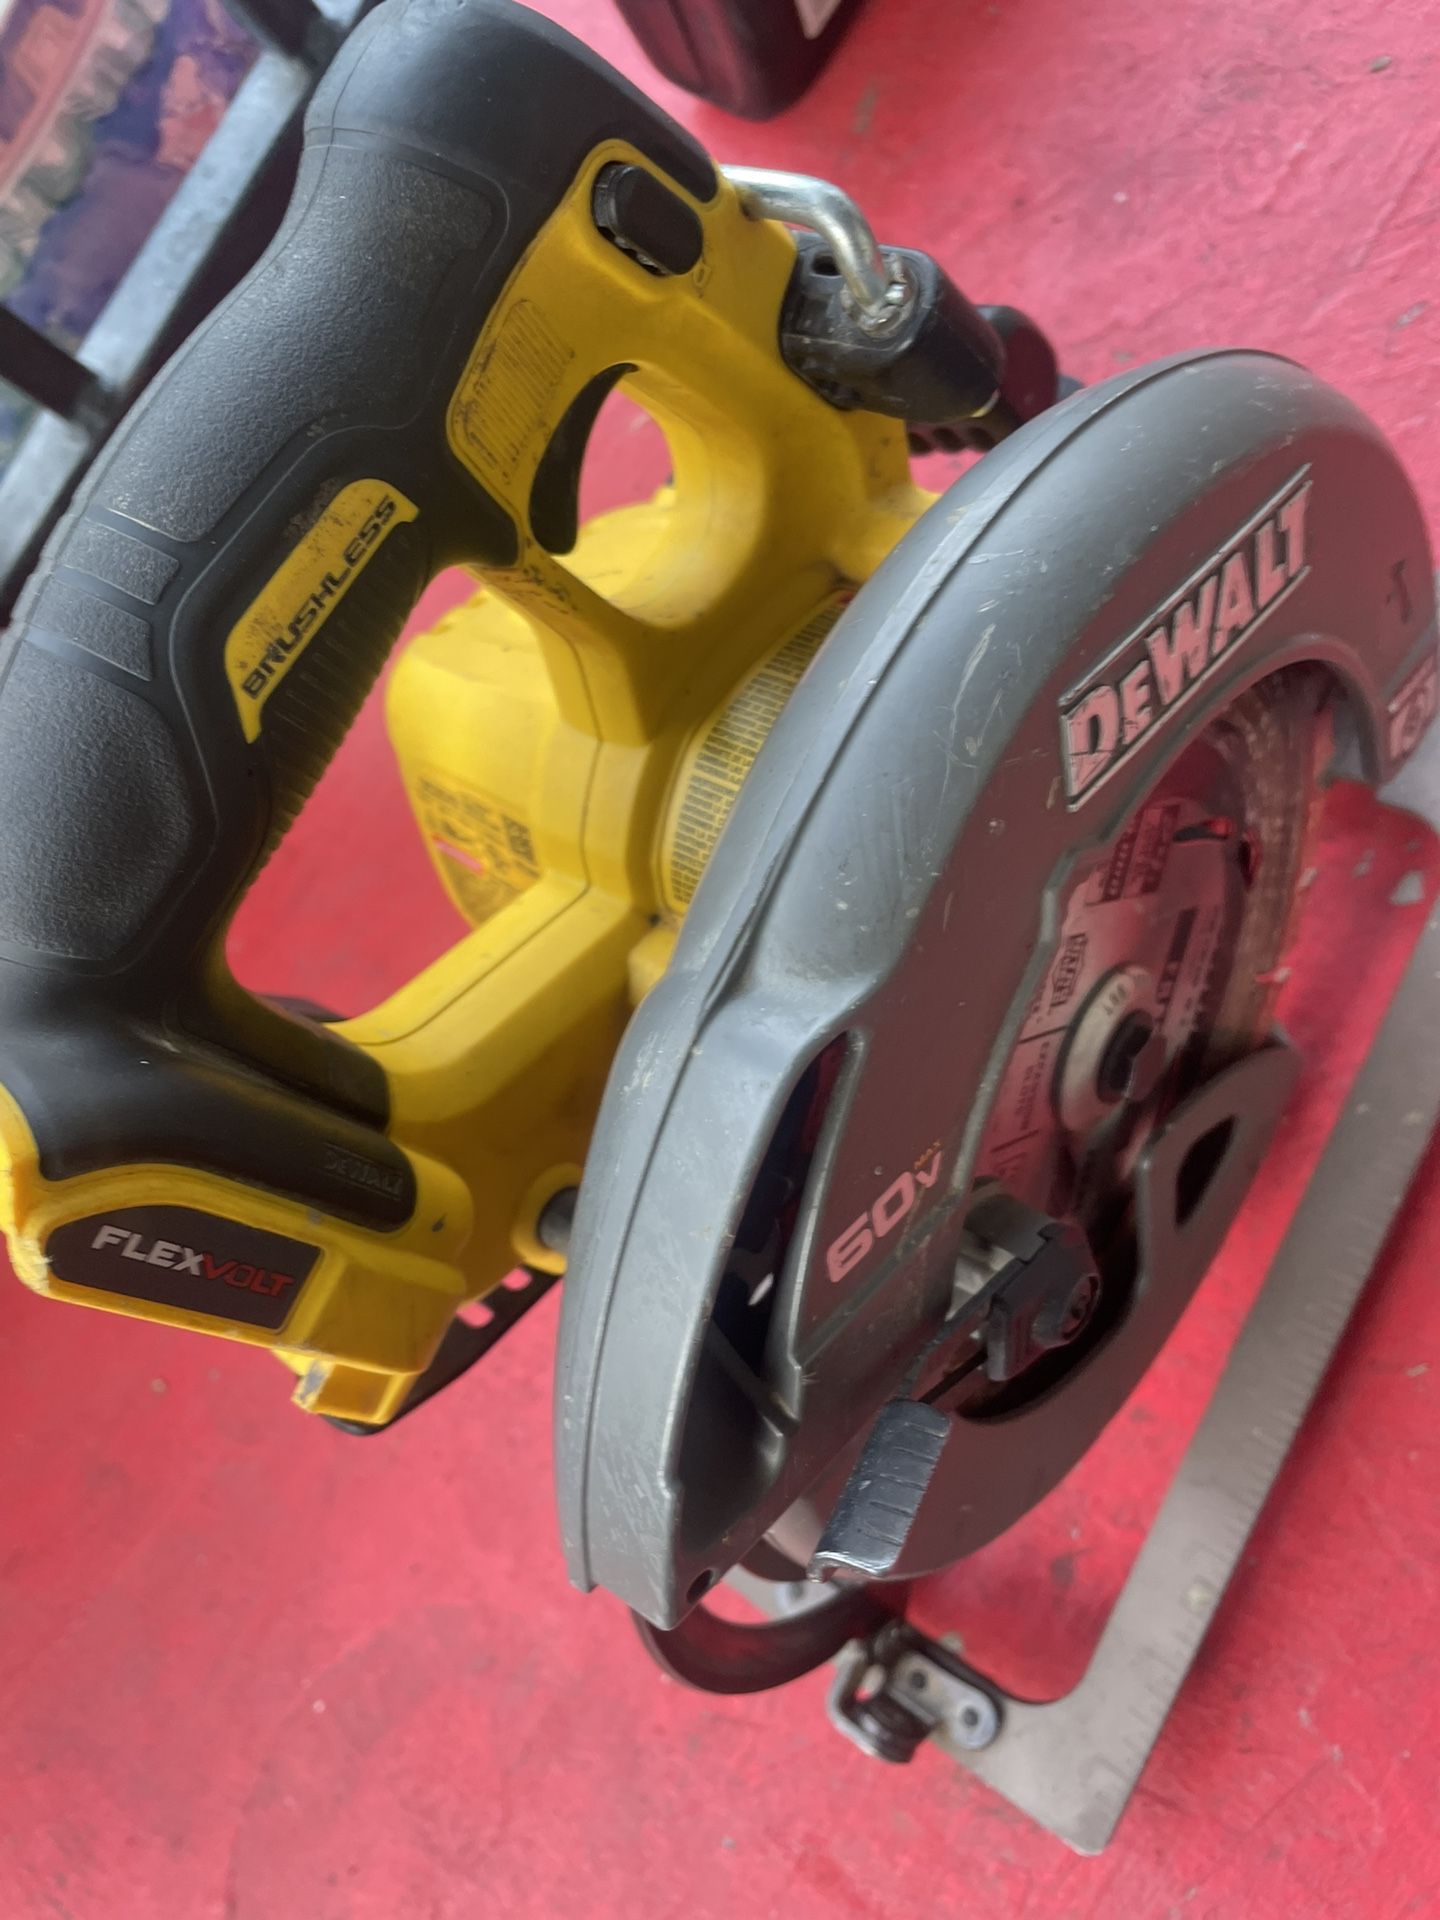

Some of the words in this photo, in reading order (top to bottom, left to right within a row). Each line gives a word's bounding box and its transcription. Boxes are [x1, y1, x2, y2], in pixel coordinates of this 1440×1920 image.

[242, 495, 396, 699] BRUSHLESS
[92, 1225, 296, 1297] FLEXVOLT
[827, 1151, 942, 1282] 60V
